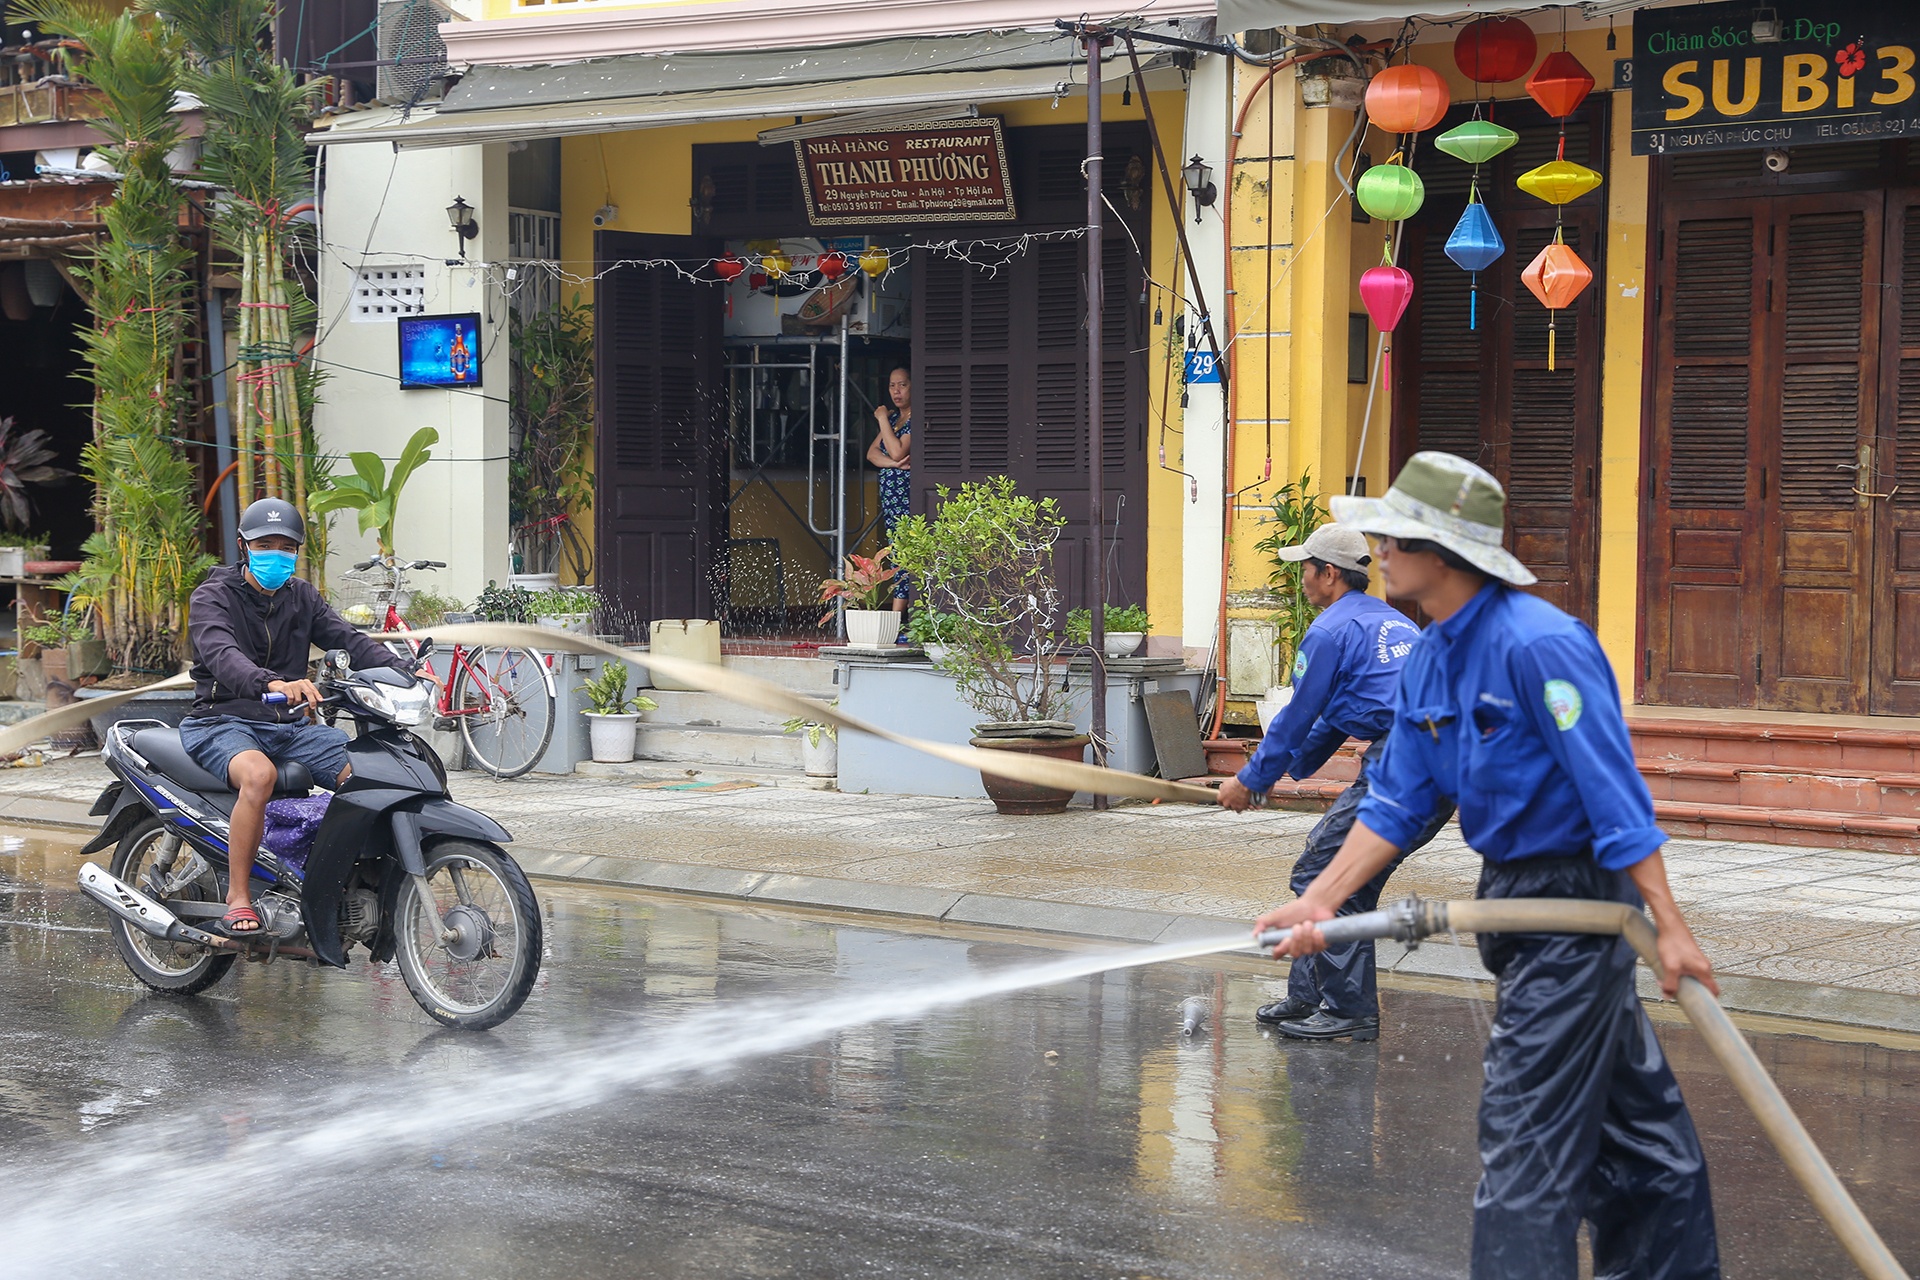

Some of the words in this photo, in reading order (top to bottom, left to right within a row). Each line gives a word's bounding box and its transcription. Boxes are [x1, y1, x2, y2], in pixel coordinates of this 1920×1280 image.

[1648, 29, 1704, 54] Chăm
[1707, 25, 1748, 48] Sóc
[1794, 18, 1841, 47] Đẹp
[1662, 57, 1762, 121] SU
[1649, 134, 1665, 148] 31
[1763, 128, 1792, 141] CHU
[1816, 124, 1838, 136] TEL:
[807, 140, 841, 154] NHÀ
[845, 139, 889, 153] HÀNG
[905, 135, 991, 149] RESTAURANT
[816, 160, 894, 186] THANH
[897, 152, 989, 183] PHƯƠNG
[824, 189, 838, 200] 29
[870, 190, 890, 199] Phúc
[891, 189, 908, 198] Chu
[919, 188, 929, 196] An
[931, 188, 945, 197] Hội
[954, 187, 965, 196] Tp
[966, 186, 979, 196] Hội
[982, 186, 993, 195] An
[896, 200, 919, 209] Email:
[1193, 355, 1213, 375] 29
